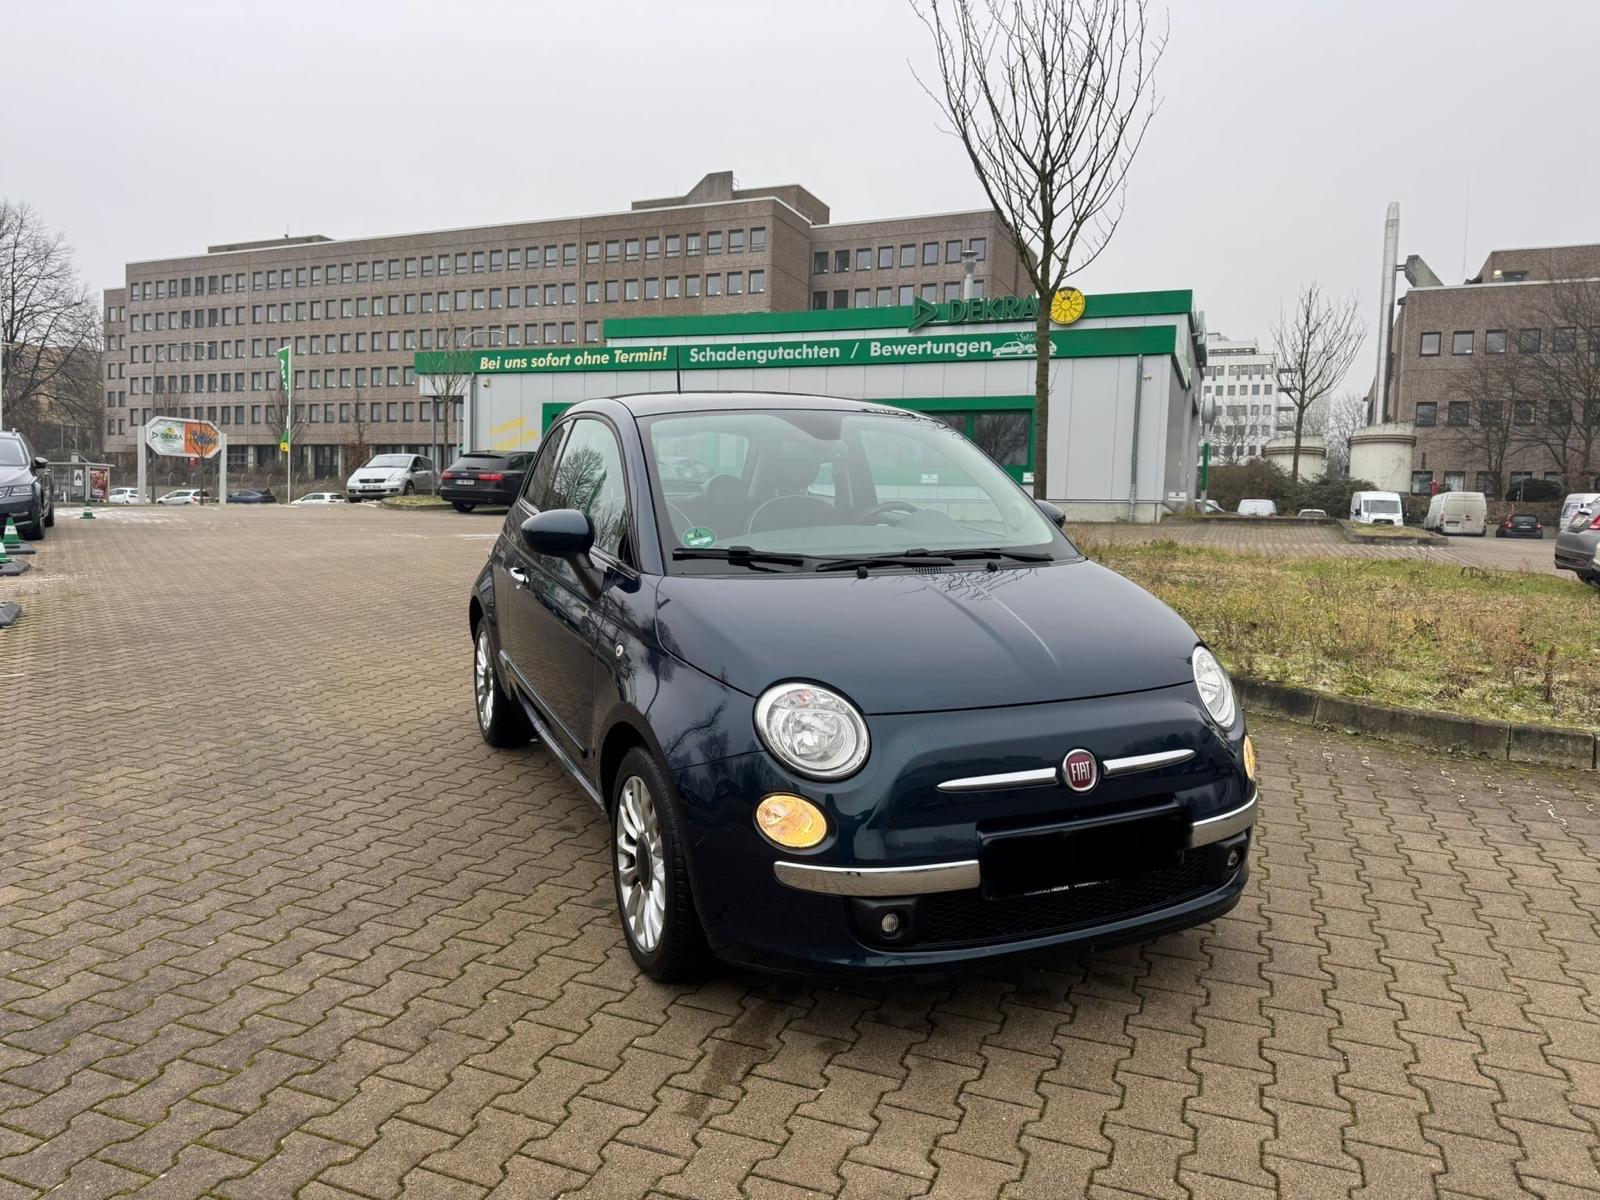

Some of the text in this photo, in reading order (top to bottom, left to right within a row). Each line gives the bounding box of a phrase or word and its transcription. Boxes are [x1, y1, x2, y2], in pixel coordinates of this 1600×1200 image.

[948, 294, 1038, 322] DEKRA
[479, 347, 668, 370] Bei uns sofort ohne Termin!
[689, 343, 840, 364] Schadengutachten
[869, 340, 992, 358] Bewertungen
[1070, 760, 1091, 782] FIAT
